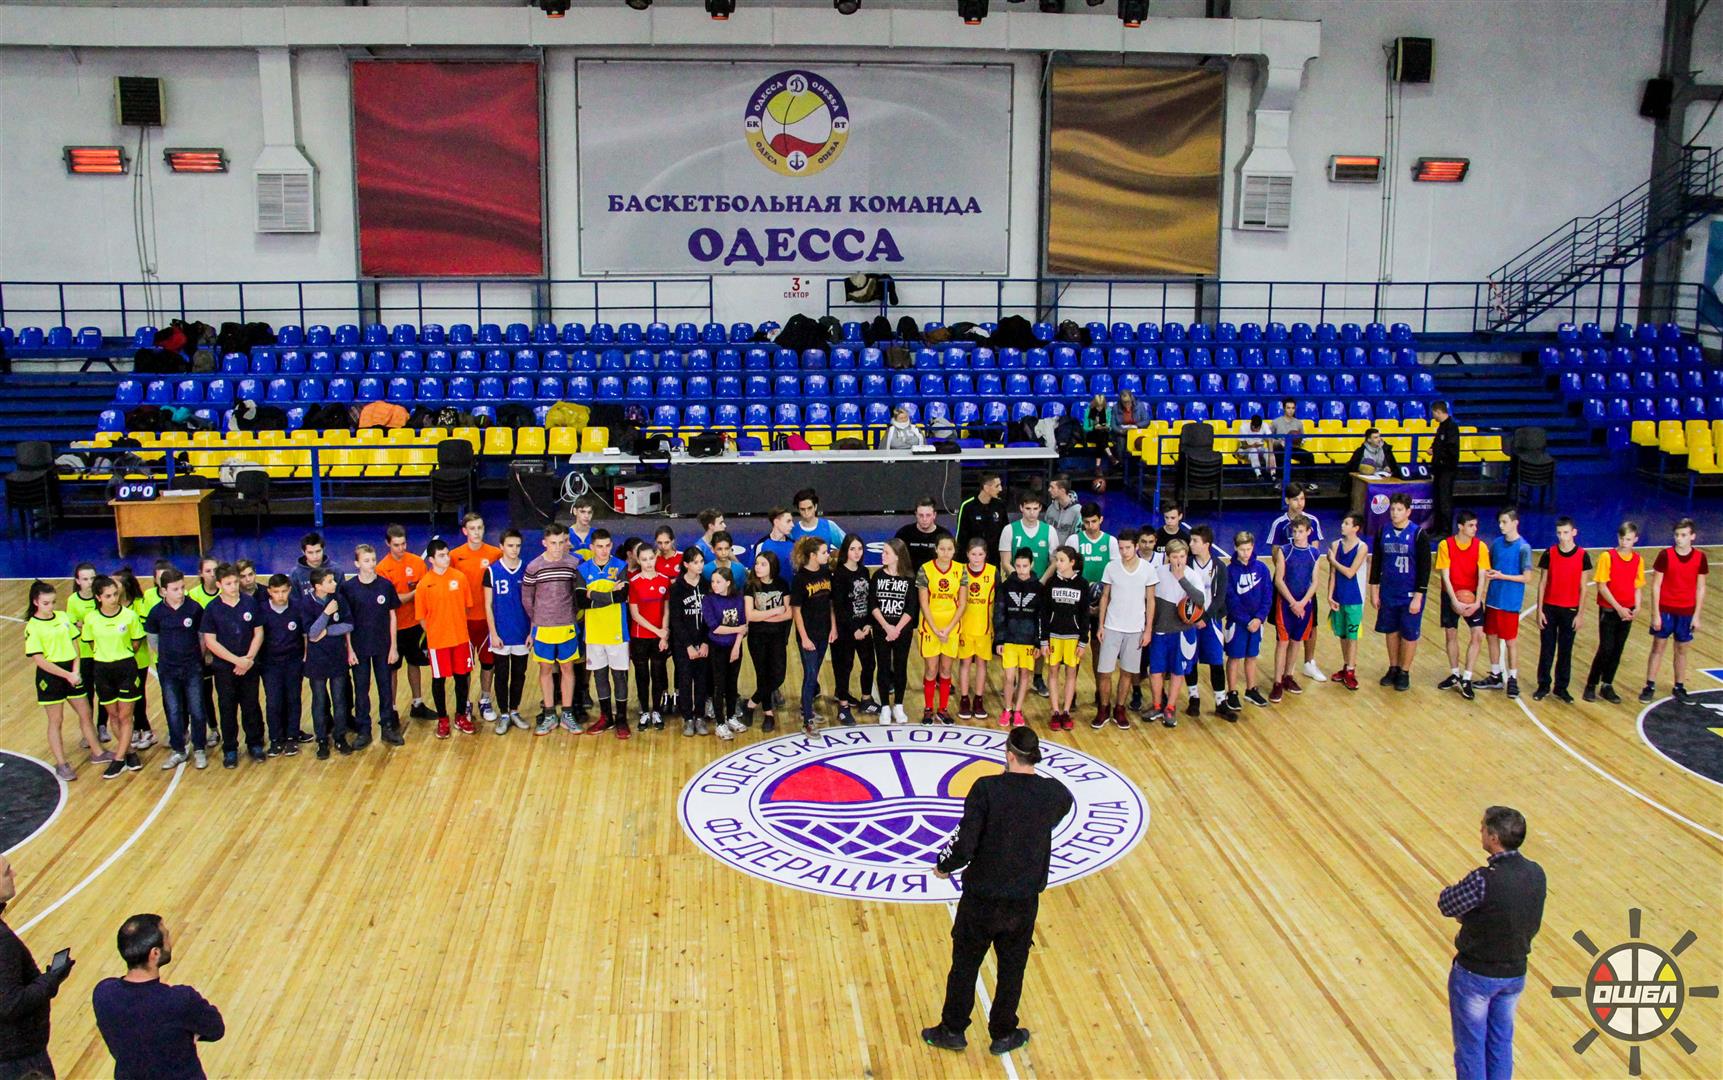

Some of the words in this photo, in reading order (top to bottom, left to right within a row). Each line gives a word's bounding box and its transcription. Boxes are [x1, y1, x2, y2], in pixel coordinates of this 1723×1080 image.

[754, 81, 784, 111] ОДЕССА
[811, 81, 840, 112] ODESSA
[607, 194, 842, 213] БАСКЕТБОЛЬНАЯ
[849, 195, 982, 216] КОМАНДА
[687, 227, 905, 267] ОДЕССА
[791, 277, 800, 291] 3
[783, 291, 810, 299] СЕКТОР
[1015, 535, 1022, 547] 7
[1080, 542, 1093, 554] 10
[1394, 556, 1409, 573] 41
[494, 579, 510, 595] 13
[877, 578, 890, 591] WE
[891, 579, 908, 592] ARE
[1052, 589, 1080, 599] EVERLAST
[879, 599, 905, 615] TARS
[701, 731, 872, 795] ОДЕССКАЯ
[886, 729, 1108, 783] ГОРОКАЯ
[703, 817, 928, 893] ФЕДЕРАЦИЯ
